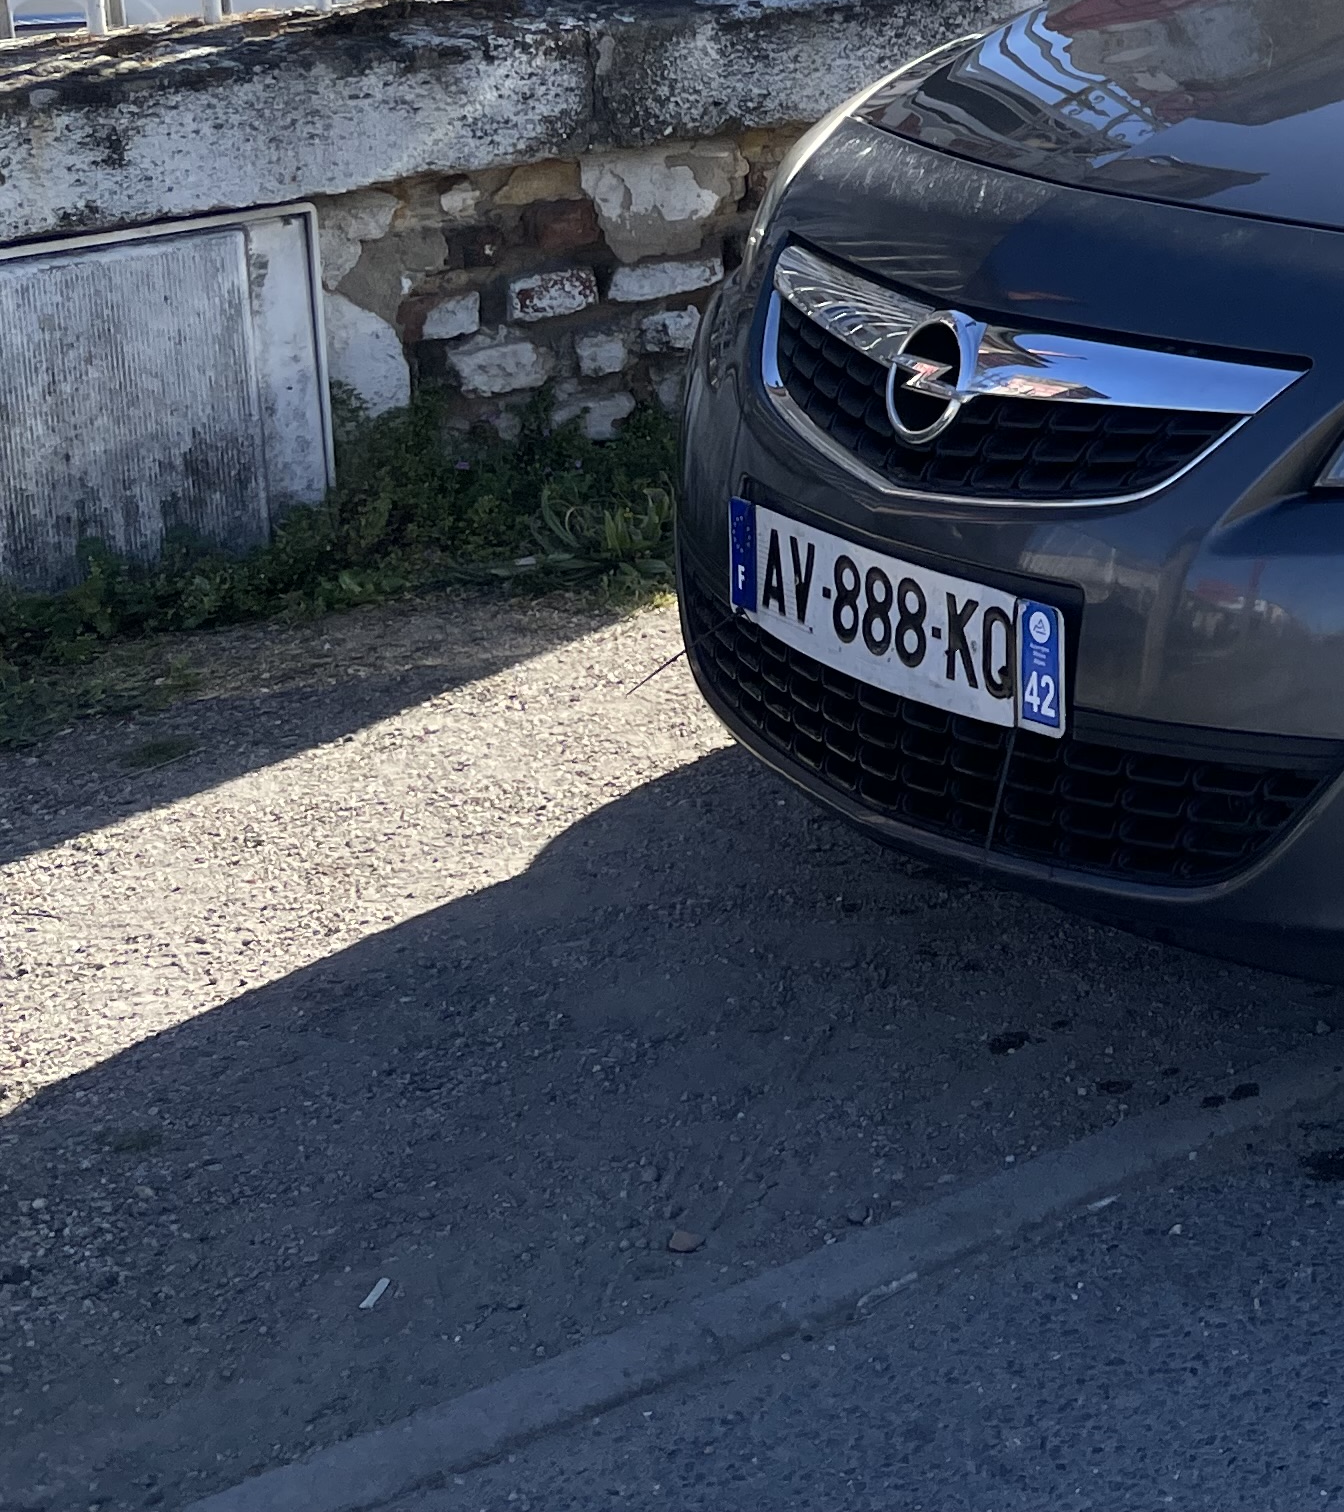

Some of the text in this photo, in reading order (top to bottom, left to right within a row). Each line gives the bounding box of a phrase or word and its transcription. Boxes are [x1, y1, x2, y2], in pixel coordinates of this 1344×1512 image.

[737, 564, 746, 590] F
[761, 528, 1014, 700] AV-888-KQ
[1024, 670, 1056, 718] 42
